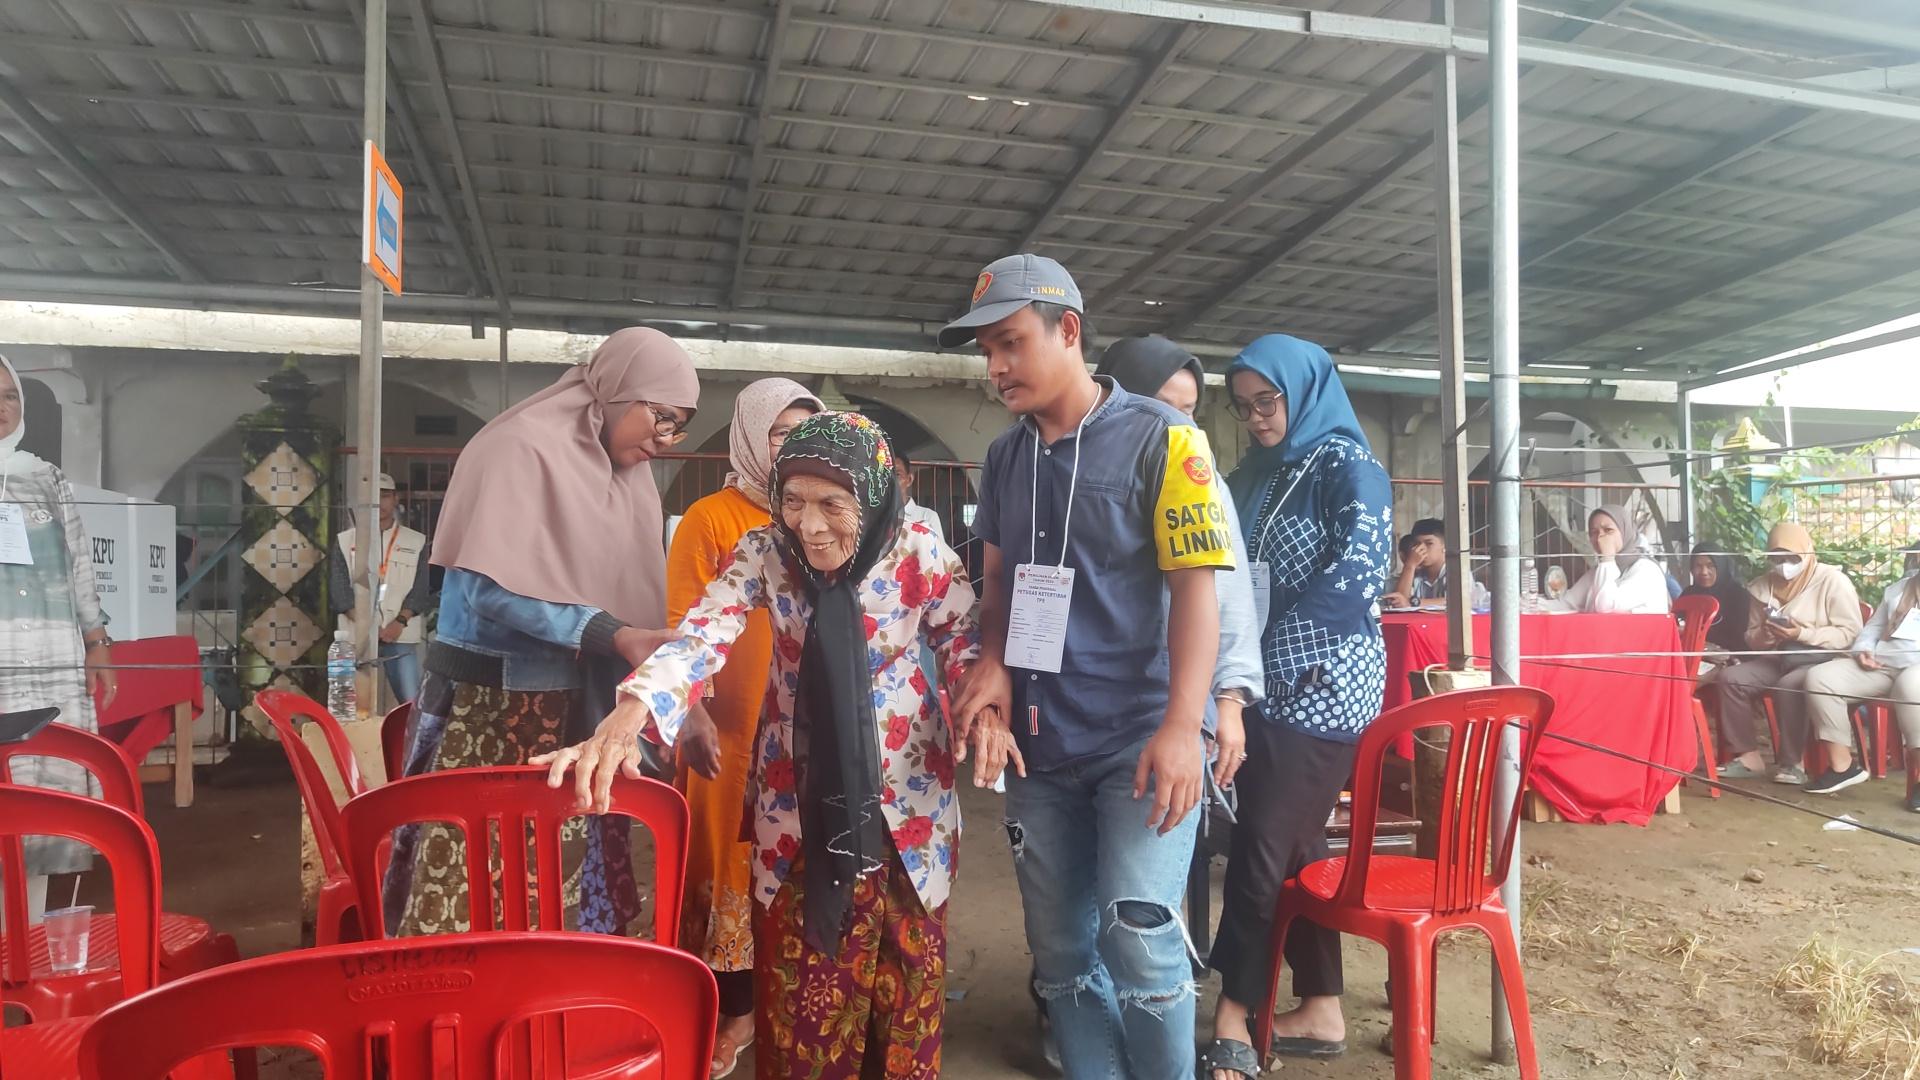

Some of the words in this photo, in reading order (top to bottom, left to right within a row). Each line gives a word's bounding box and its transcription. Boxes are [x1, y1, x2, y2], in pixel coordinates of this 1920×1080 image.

[1030, 286, 1065, 297] LINMAS
[92, 536, 115, 565] KPU
[149, 544, 166, 569] KPU
